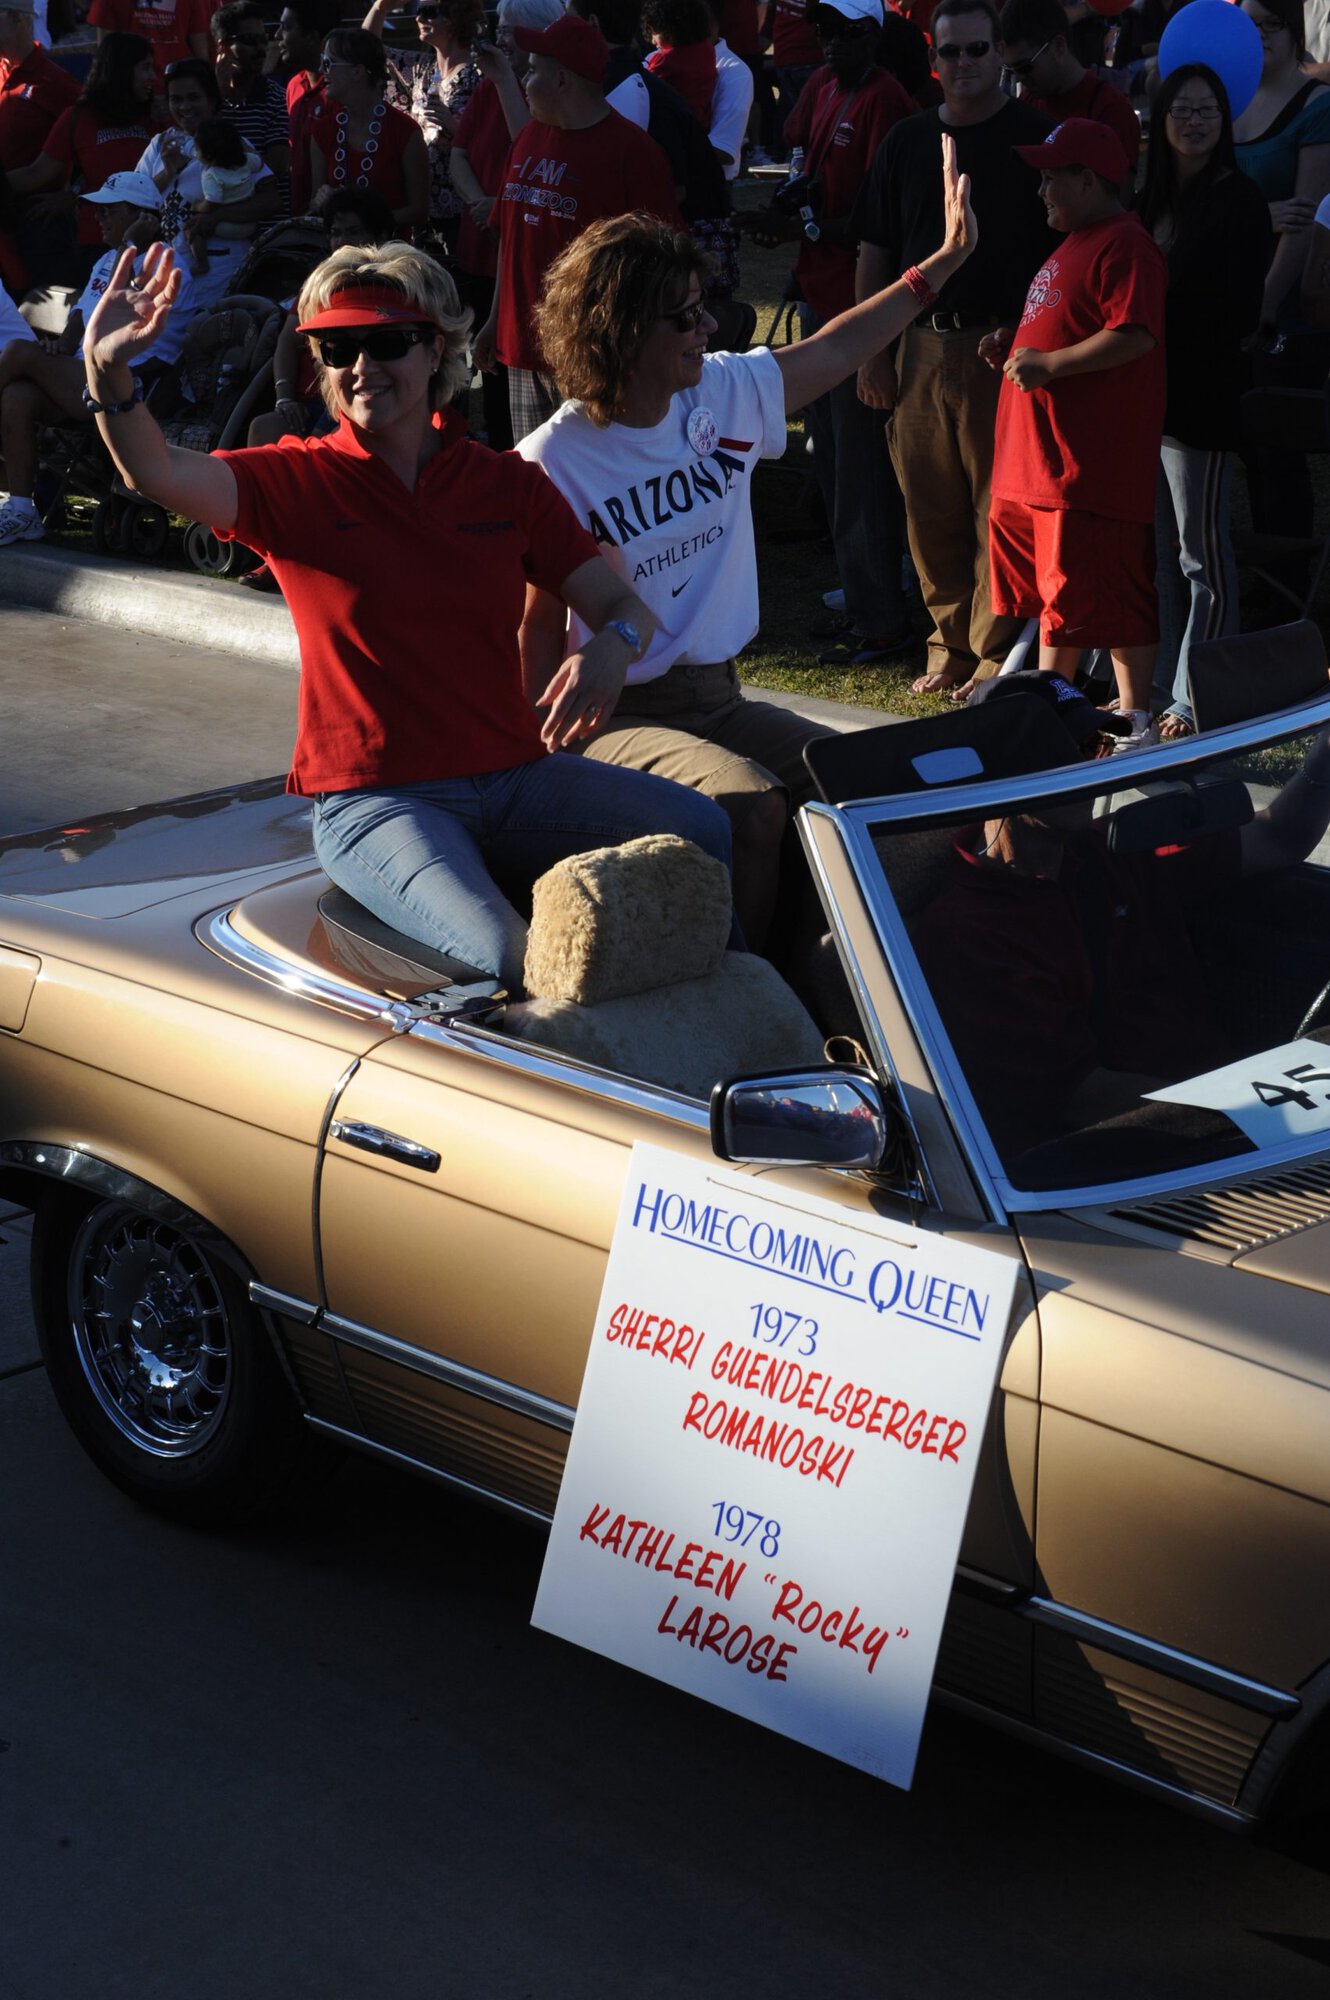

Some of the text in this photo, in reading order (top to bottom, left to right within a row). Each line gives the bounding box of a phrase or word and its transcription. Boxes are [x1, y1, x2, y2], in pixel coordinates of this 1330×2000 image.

[527, 158, 568, 187] AM
[632, 1183, 990, 1332] HOMECOMING QUEEN
[749, 1303, 819, 1357] 1973
[605, 1303, 968, 1463] SHERRI GUENDELSBERGER
[682, 1390, 855, 1488] ROMANOSKI
[579, 1503, 747, 1601] KATHLEEN
[711, 1500, 782, 1559] 1978
[656, 1595, 798, 1682] LAROSE
